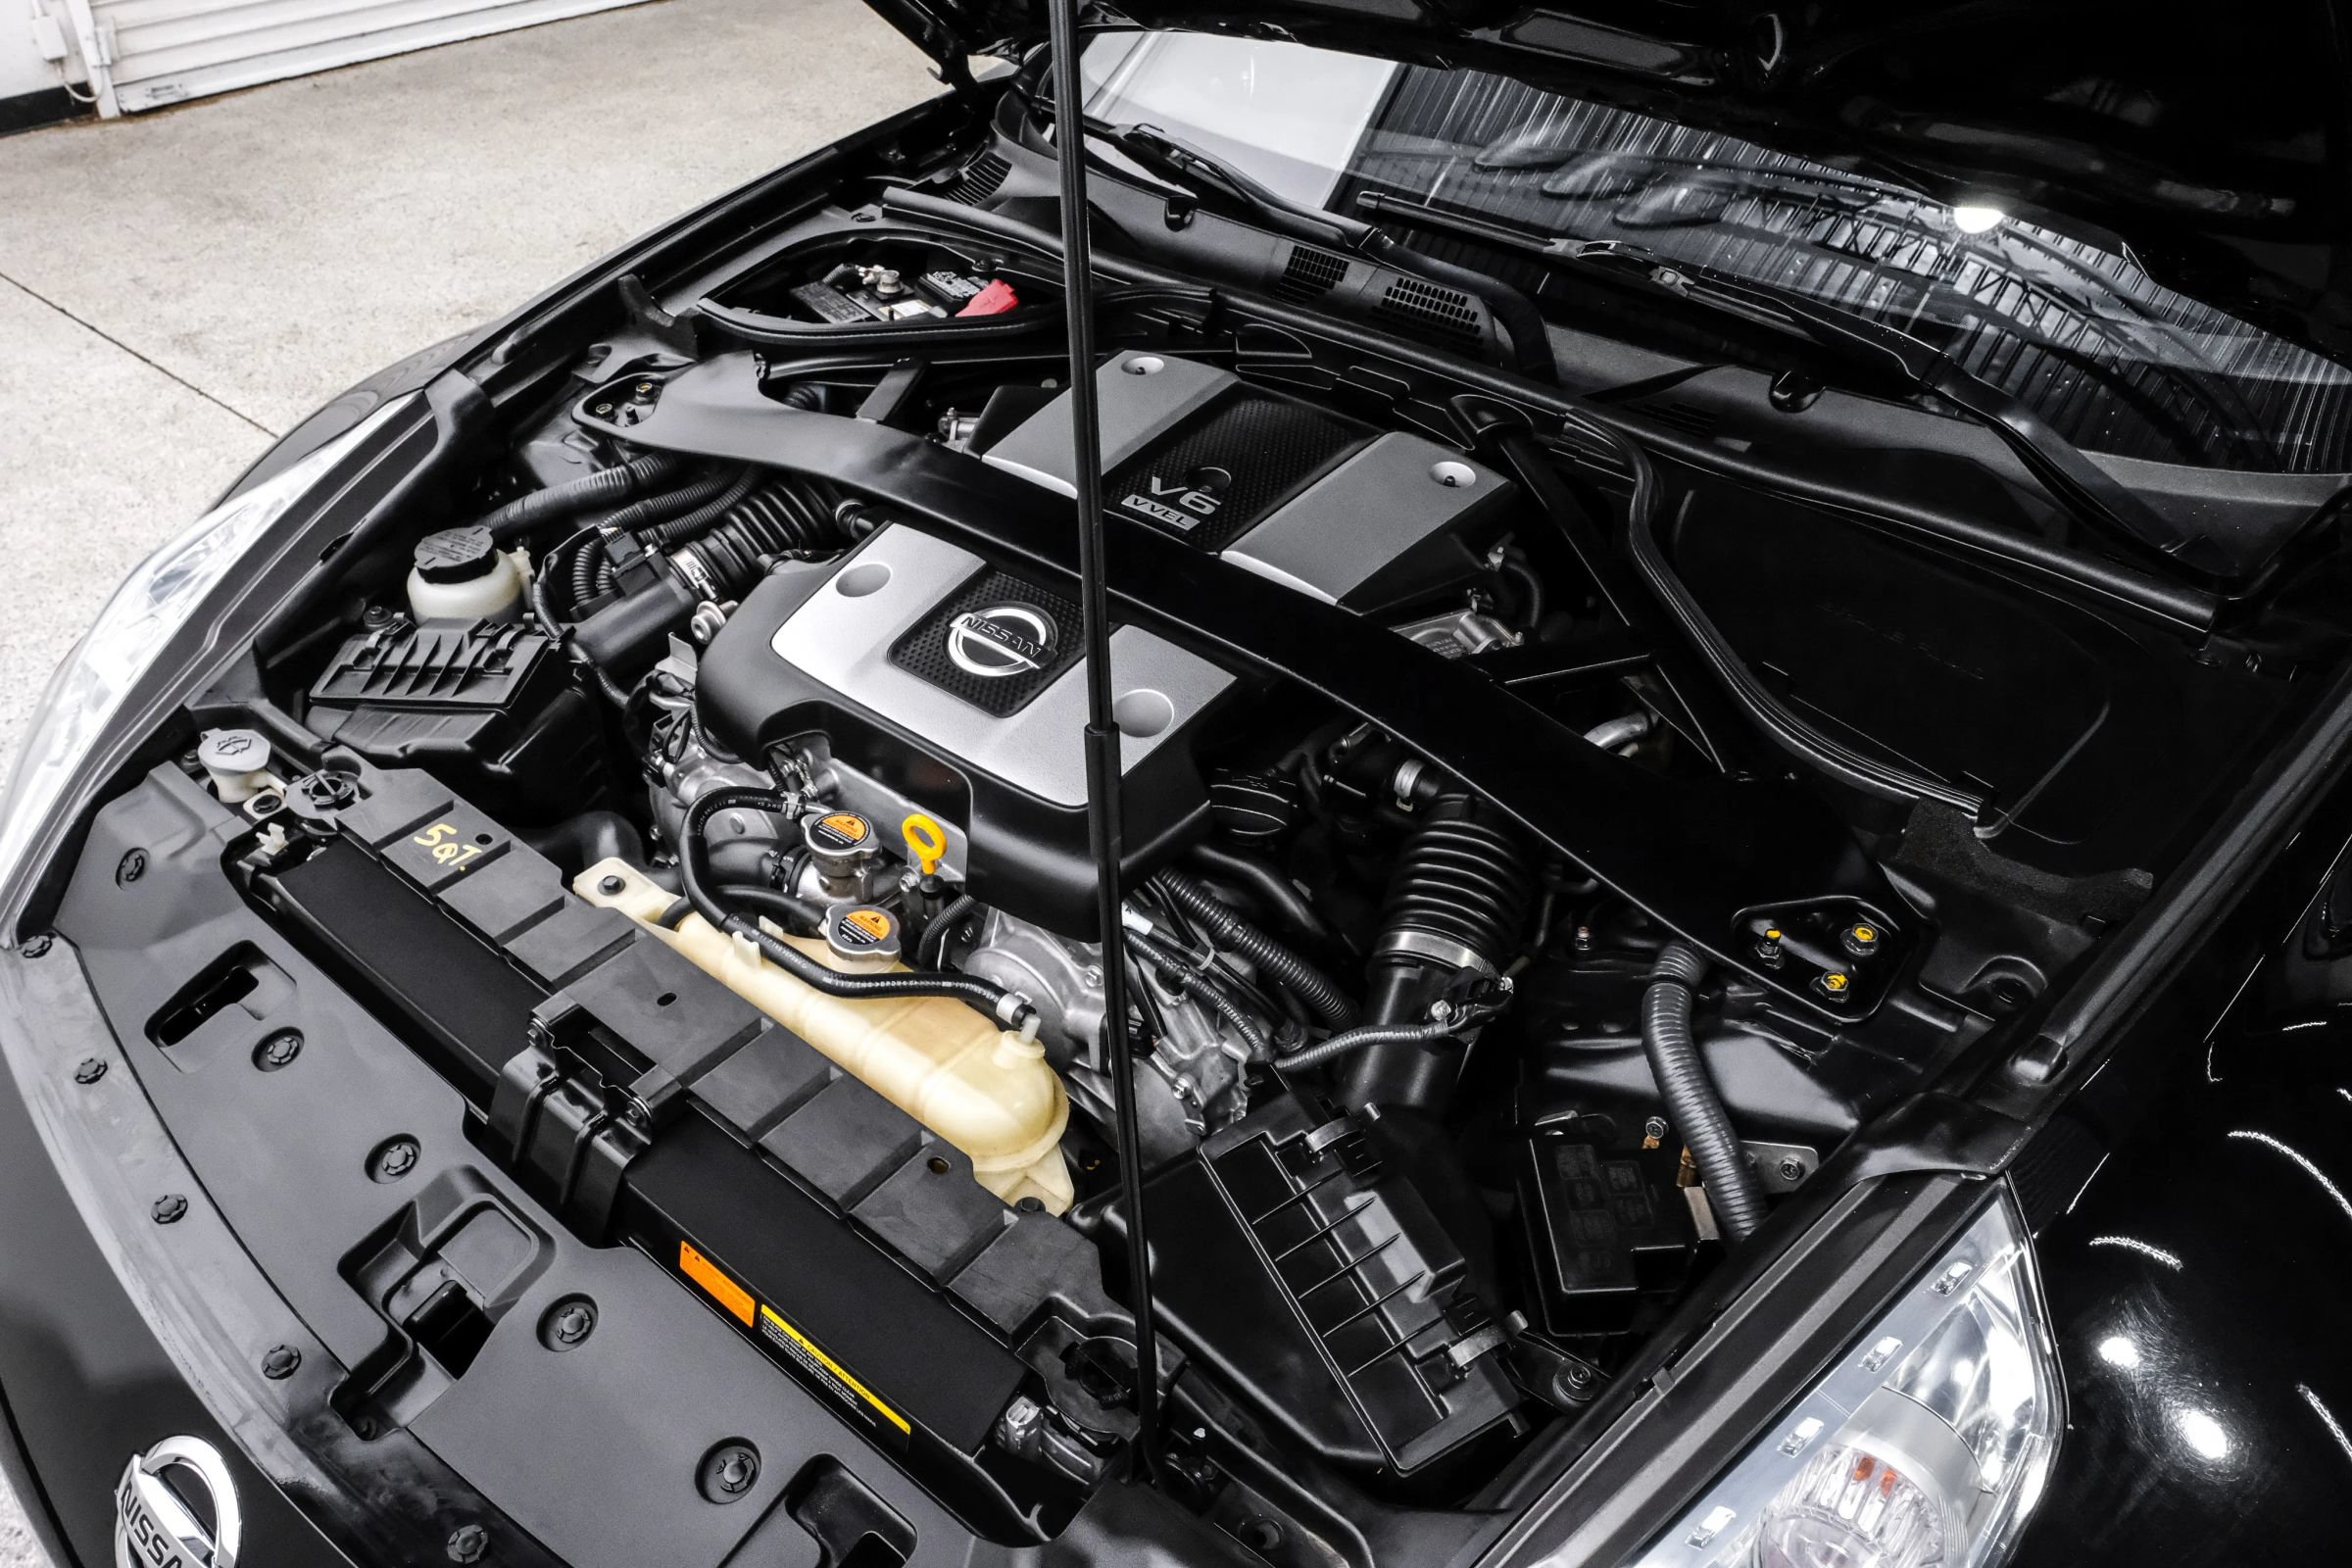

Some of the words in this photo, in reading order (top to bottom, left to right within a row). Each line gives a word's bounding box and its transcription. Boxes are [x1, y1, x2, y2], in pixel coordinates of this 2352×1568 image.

[1133, 497, 1187, 526] VVEL
[1151, 476, 1221, 514] V6
[961, 616, 1042, 658] NISSAN
[807, 1345, 833, 1368] CAUTION
[838, 1371, 870, 1399] ATTENTION
